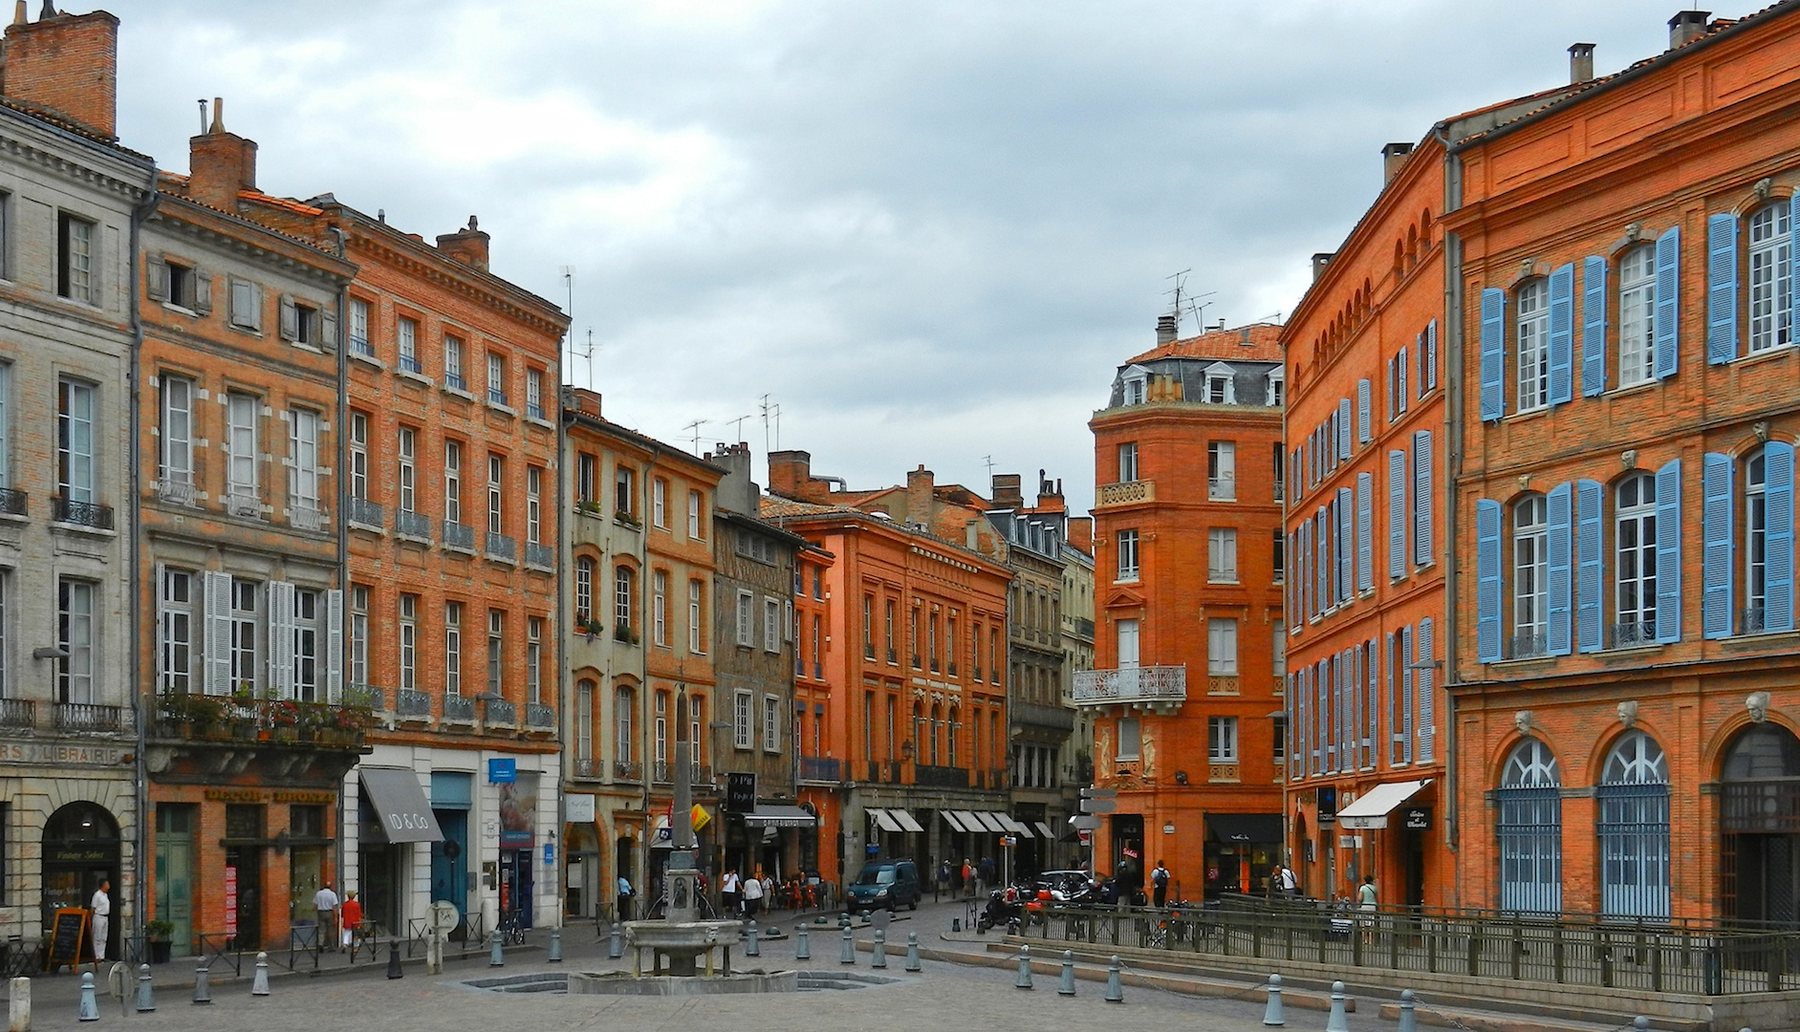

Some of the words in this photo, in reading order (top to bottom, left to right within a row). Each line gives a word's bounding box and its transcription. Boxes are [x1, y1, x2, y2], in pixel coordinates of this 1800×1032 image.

[43, 746, 118, 761] LIBRAIRIE
[389, 813, 403, 830] ID
[403, 813, 413, 830] &
[413, 813, 429, 830] Co
